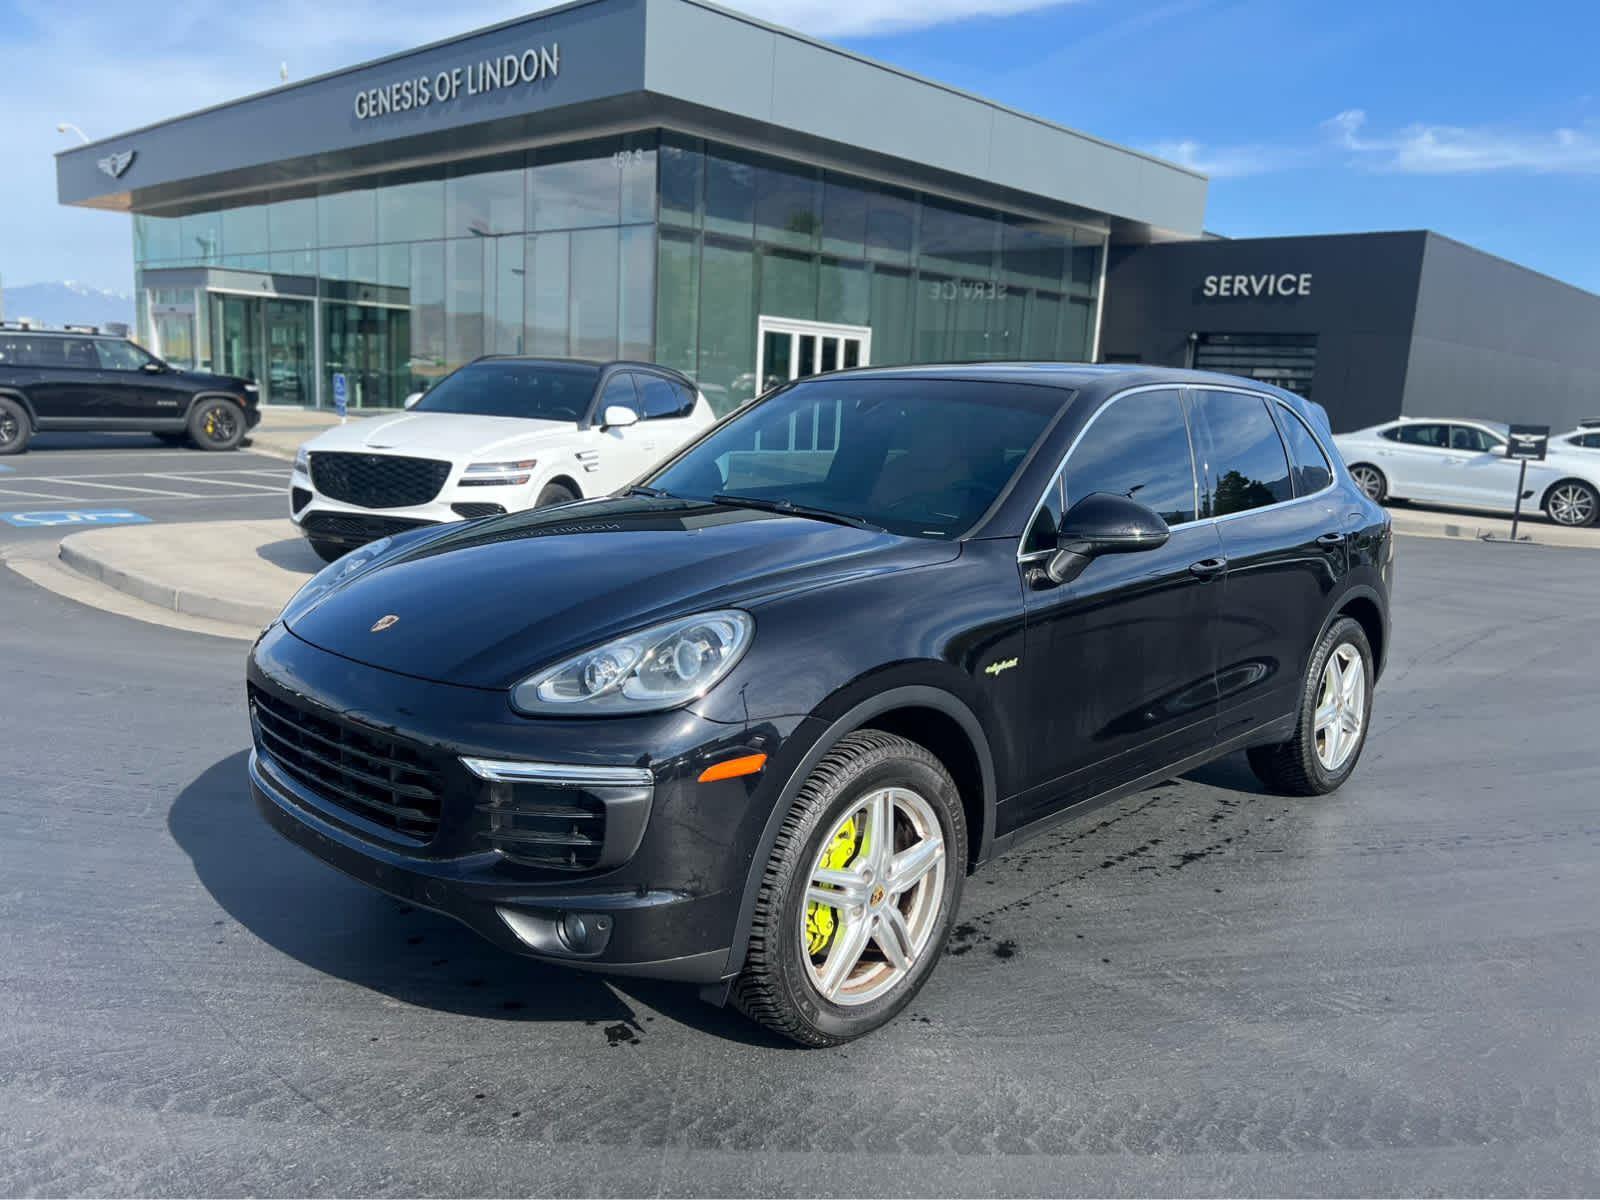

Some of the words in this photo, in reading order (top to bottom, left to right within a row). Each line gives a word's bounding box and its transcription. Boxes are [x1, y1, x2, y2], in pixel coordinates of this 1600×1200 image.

[355, 76, 431, 119] GENESIS
[435, 68, 462, 102] OF
[468, 43, 560, 95] LINDON
[1203, 273, 1312, 297] SERVICE
